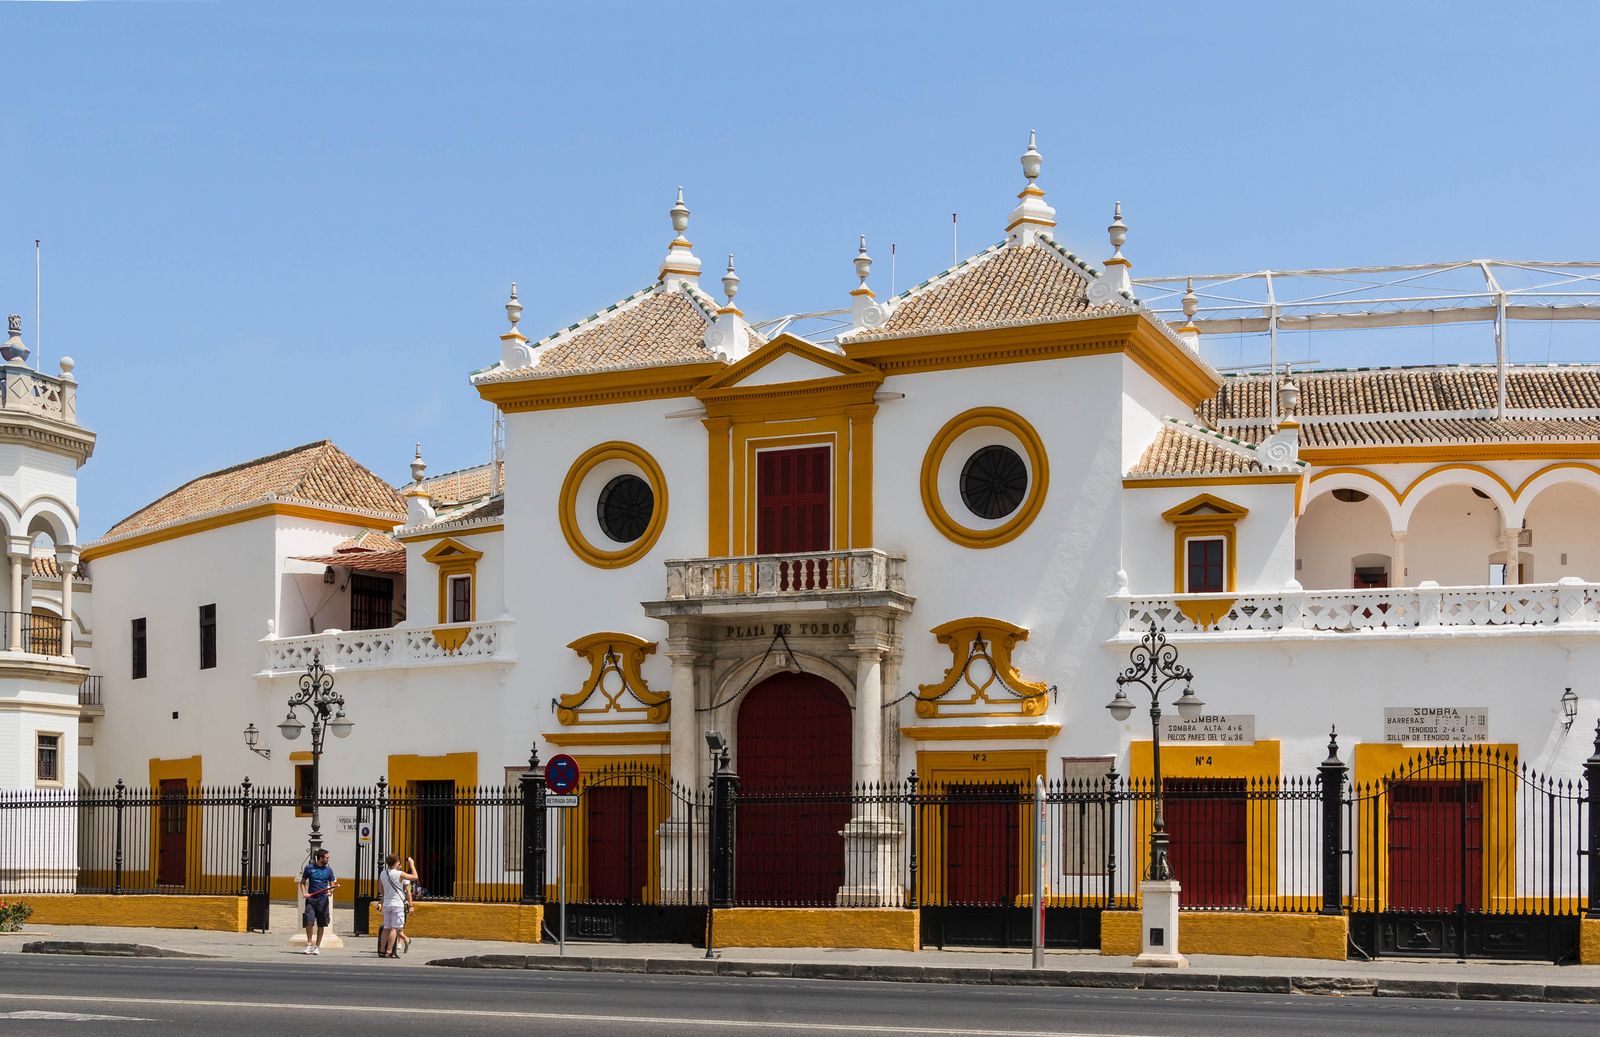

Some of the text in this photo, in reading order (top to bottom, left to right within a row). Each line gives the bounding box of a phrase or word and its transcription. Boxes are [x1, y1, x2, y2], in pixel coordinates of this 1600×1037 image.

[726, 624, 766, 638] PLAZA
[800, 624, 850, 634] TOROS
[1206, 756, 1212, 766] 4
[1439, 756, 1446, 766] 6
